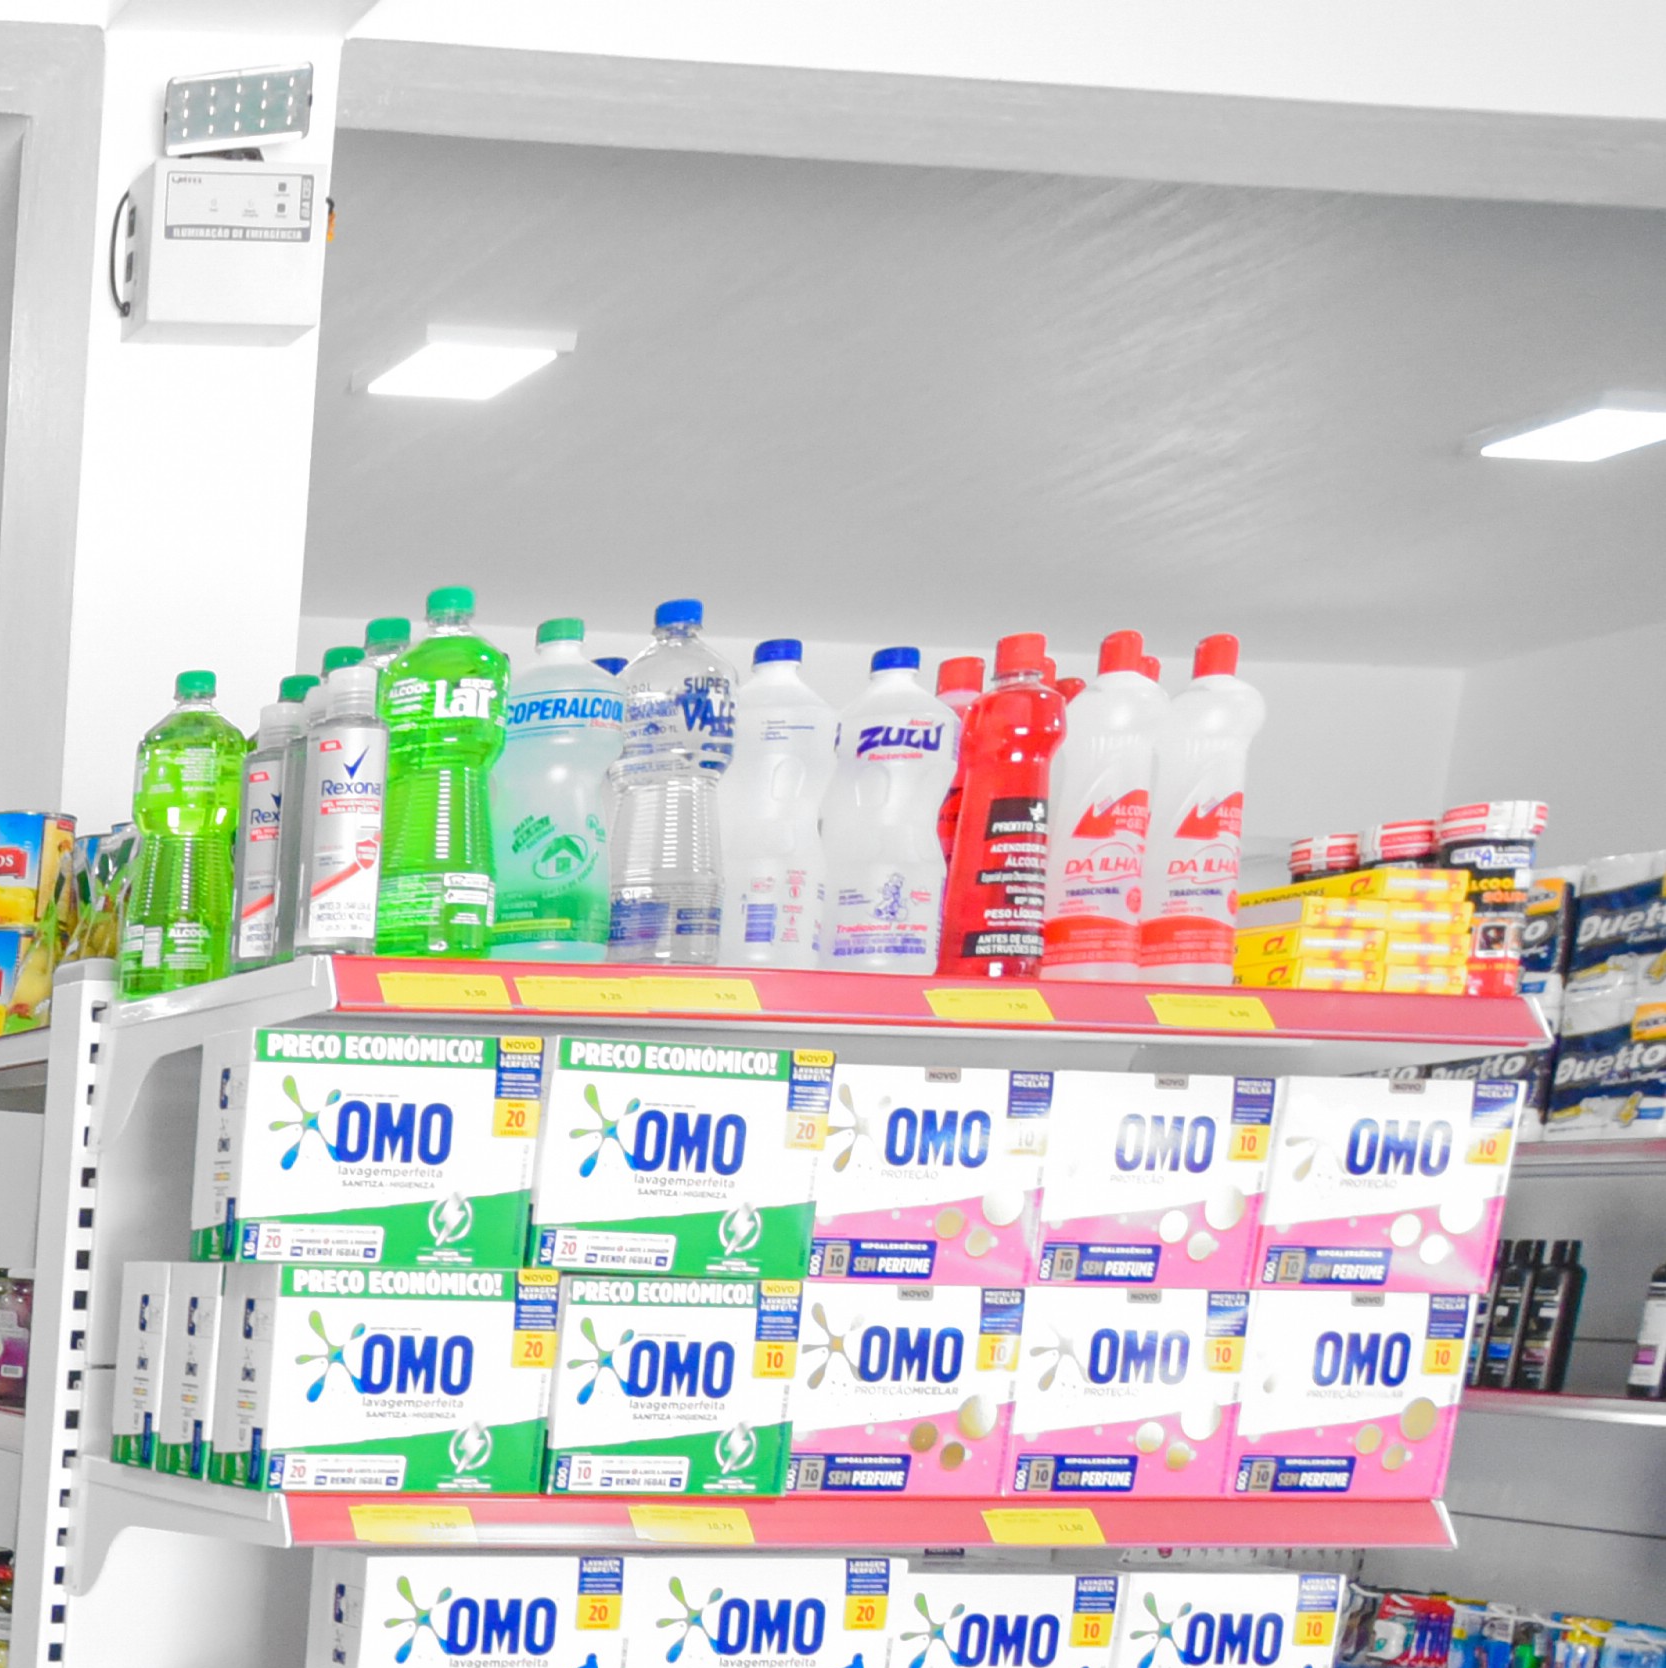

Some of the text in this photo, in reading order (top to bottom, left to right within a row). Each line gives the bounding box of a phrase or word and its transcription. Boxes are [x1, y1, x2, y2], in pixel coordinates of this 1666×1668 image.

[321, 779, 380, 797] Rexona
[250, 809, 280, 825] Rex
[1576, 900, 1666, 945] Duet
[267, 1032, 484, 1064] PREÇO ECONÔMICO!
[506, 1039, 536, 1051] NOVO
[570, 1040, 777, 1076] PREÇO ECONÔMICO!
[799, 1053, 828, 1064] NOVO
[336, 1101, 454, 1165] OMO
[505, 1109, 526, 1128] 20
[796, 1122, 815, 1140] 20
[633, 1109, 747, 1176] OMO
[884, 1107, 992, 1169] OMO
[1115, 1113, 1216, 1173] OMO
[1240, 1136, 1257, 1153] 10
[1345, 1117, 1454, 1177] OMO
[1478, 1140, 1497, 1156] 10
[877, 1257, 931, 1276] PERFUME
[1104, 1261, 1155, 1280] PERFUME
[1331, 1263, 1386, 1282] PERFUME
[293, 1268, 502, 1297] PREÇO ECONÔMICO!
[573, 1280, 754, 1305] PREÇO ECONÔMICO!
[766, 1284, 796, 1294] NOVO
[523, 1340, 544, 1359] 20
[859, 1325, 964, 1384] OMO
[1090, 1328, 1189, 1385] OMO
[1313, 1331, 1412, 1386] OMO
[363, 1334, 474, 1396] OMO
[627, 1340, 735, 1398] OMO
[851, 1470, 905, 1488] PERFUME
[447, 1597, 557, 1656] OMO
[588, 1604, 609, 1623] 20
[717, 1597, 826, 1656] OMO
[958, 1612, 1060, 1668] OMO
[1183, 1612, 1283, 1667] OMO
[1304, 1621, 1323, 1638] 10
